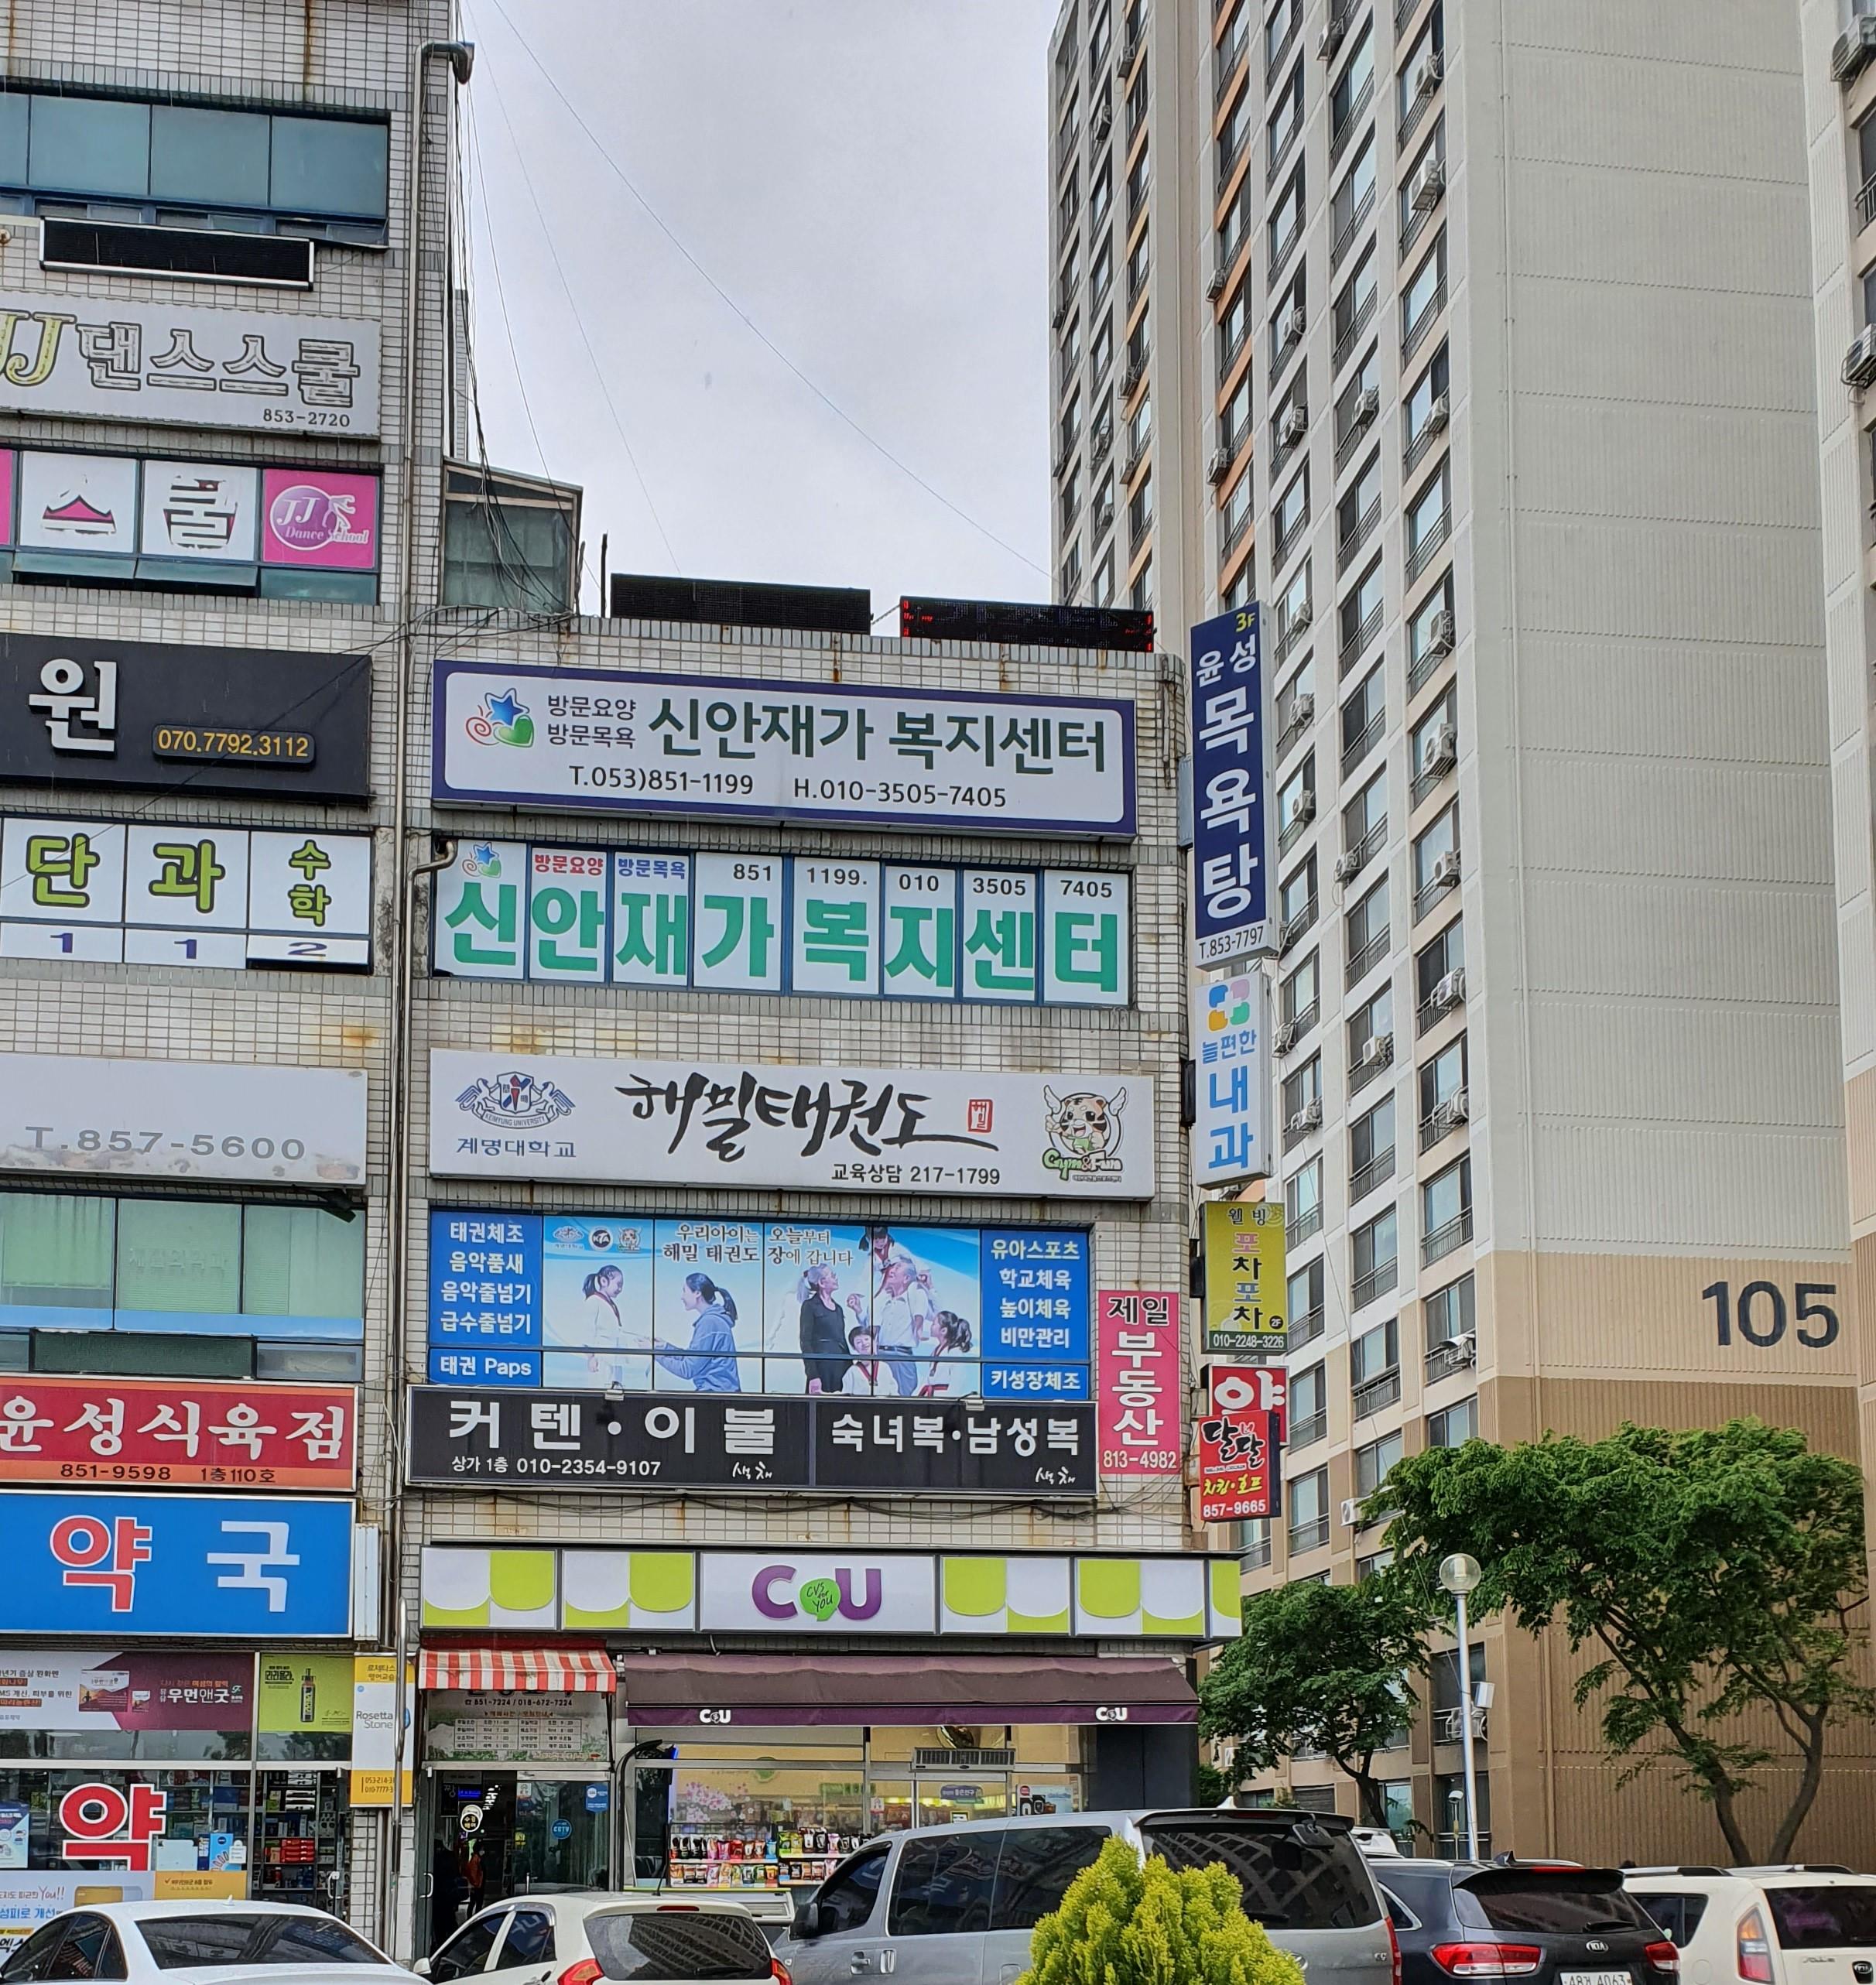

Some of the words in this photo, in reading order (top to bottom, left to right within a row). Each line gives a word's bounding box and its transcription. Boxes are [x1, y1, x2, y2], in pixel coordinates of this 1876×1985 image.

[263, 409, 351, 428] 853-2720
[276, 496, 320, 526] JJ
[285, 525, 324, 542] Dance
[1235, 611, 1255, 633] 3F
[1196, 633, 1257, 688] 윤성
[29, 658, 117, 752] 원
[547, 694, 637, 722] 방문요양
[158, 729, 309, 758] 070.7792.3112
[547, 724, 636, 750] 방문목욕
[569, 765, 754, 795] T.053)851-1199
[793, 777, 1007, 807] H.010-3505-7405
[1199, 686, 1258, 919] 목욕탕
[534, 854, 604, 876] 방문요양
[618, 857, 686, 880] 방문목욕
[289, 840, 331, 927] 수학
[733, 863, 772, 882] 851
[899, 873, 940, 892] 010
[972, 877, 1026, 896] 3505
[1060, 879, 1113, 898] 7405
[1199, 926, 1265, 960] T.853-7797
[1202, 1029, 1257, 1065] 늘편한
[1208, 1065, 1254, 1170] 내과
[25, 1126, 306, 1161] T.857-5600
[456, 1138, 577, 1158] 계명대학교
[830, 1163, 902, 1184] 교육상담
[909, 1165, 1001, 1186] 217-1799
[450, 1221, 525, 1244] 태권체조
[676, 1223, 759, 1244] 우리아이는
[769, 1227, 830, 1245] 오늘부터
[662, 1243, 699, 1262] 해밀
[991, 1240, 1080, 1260] 유아스포츠
[449, 1251, 524, 1275] 음악품새
[999, 1269, 1072, 1291] 학교체육
[440, 1281, 532, 1305] 음악줄넘기
[1107, 1295, 1170, 1326] 제일
[1271, 1318, 1282, 1326] 2F
[1702, 1281, 1840, 1348] 105
[440, 1311, 532, 1335] 급수줄넘기
[1001, 1328, 1070, 1349] 비만관리
[1212, 1333, 1285, 1349] 010-2248-3226
[440, 1355, 477, 1376] 태권
[484, 1358, 532, 1378] Paps
[991, 1370, 1081, 1391] 키성장체조
[1111, 1331, 1164, 1446] 부동산
[0, 1395, 345, 1461] 윤성식육점
[452, 1456, 481, 1473] 상가
[487, 1457, 508, 1473] 1층
[517, 1457, 661, 1477] 010-2354-9107
[1103, 1450, 1177, 1470] 813-4982
[61, 1464, 171, 1480] 851-9598
[1203, 1499, 1266, 1518] 857-9665
[812, 1594, 833, 1613] YOU
[167, 1688, 231, 1703] 우먼앤굿
[356, 1710, 394, 1720] Rosetta
[365, 1720, 393, 1729] Stone
[59, 1782, 167, 1871] 약
